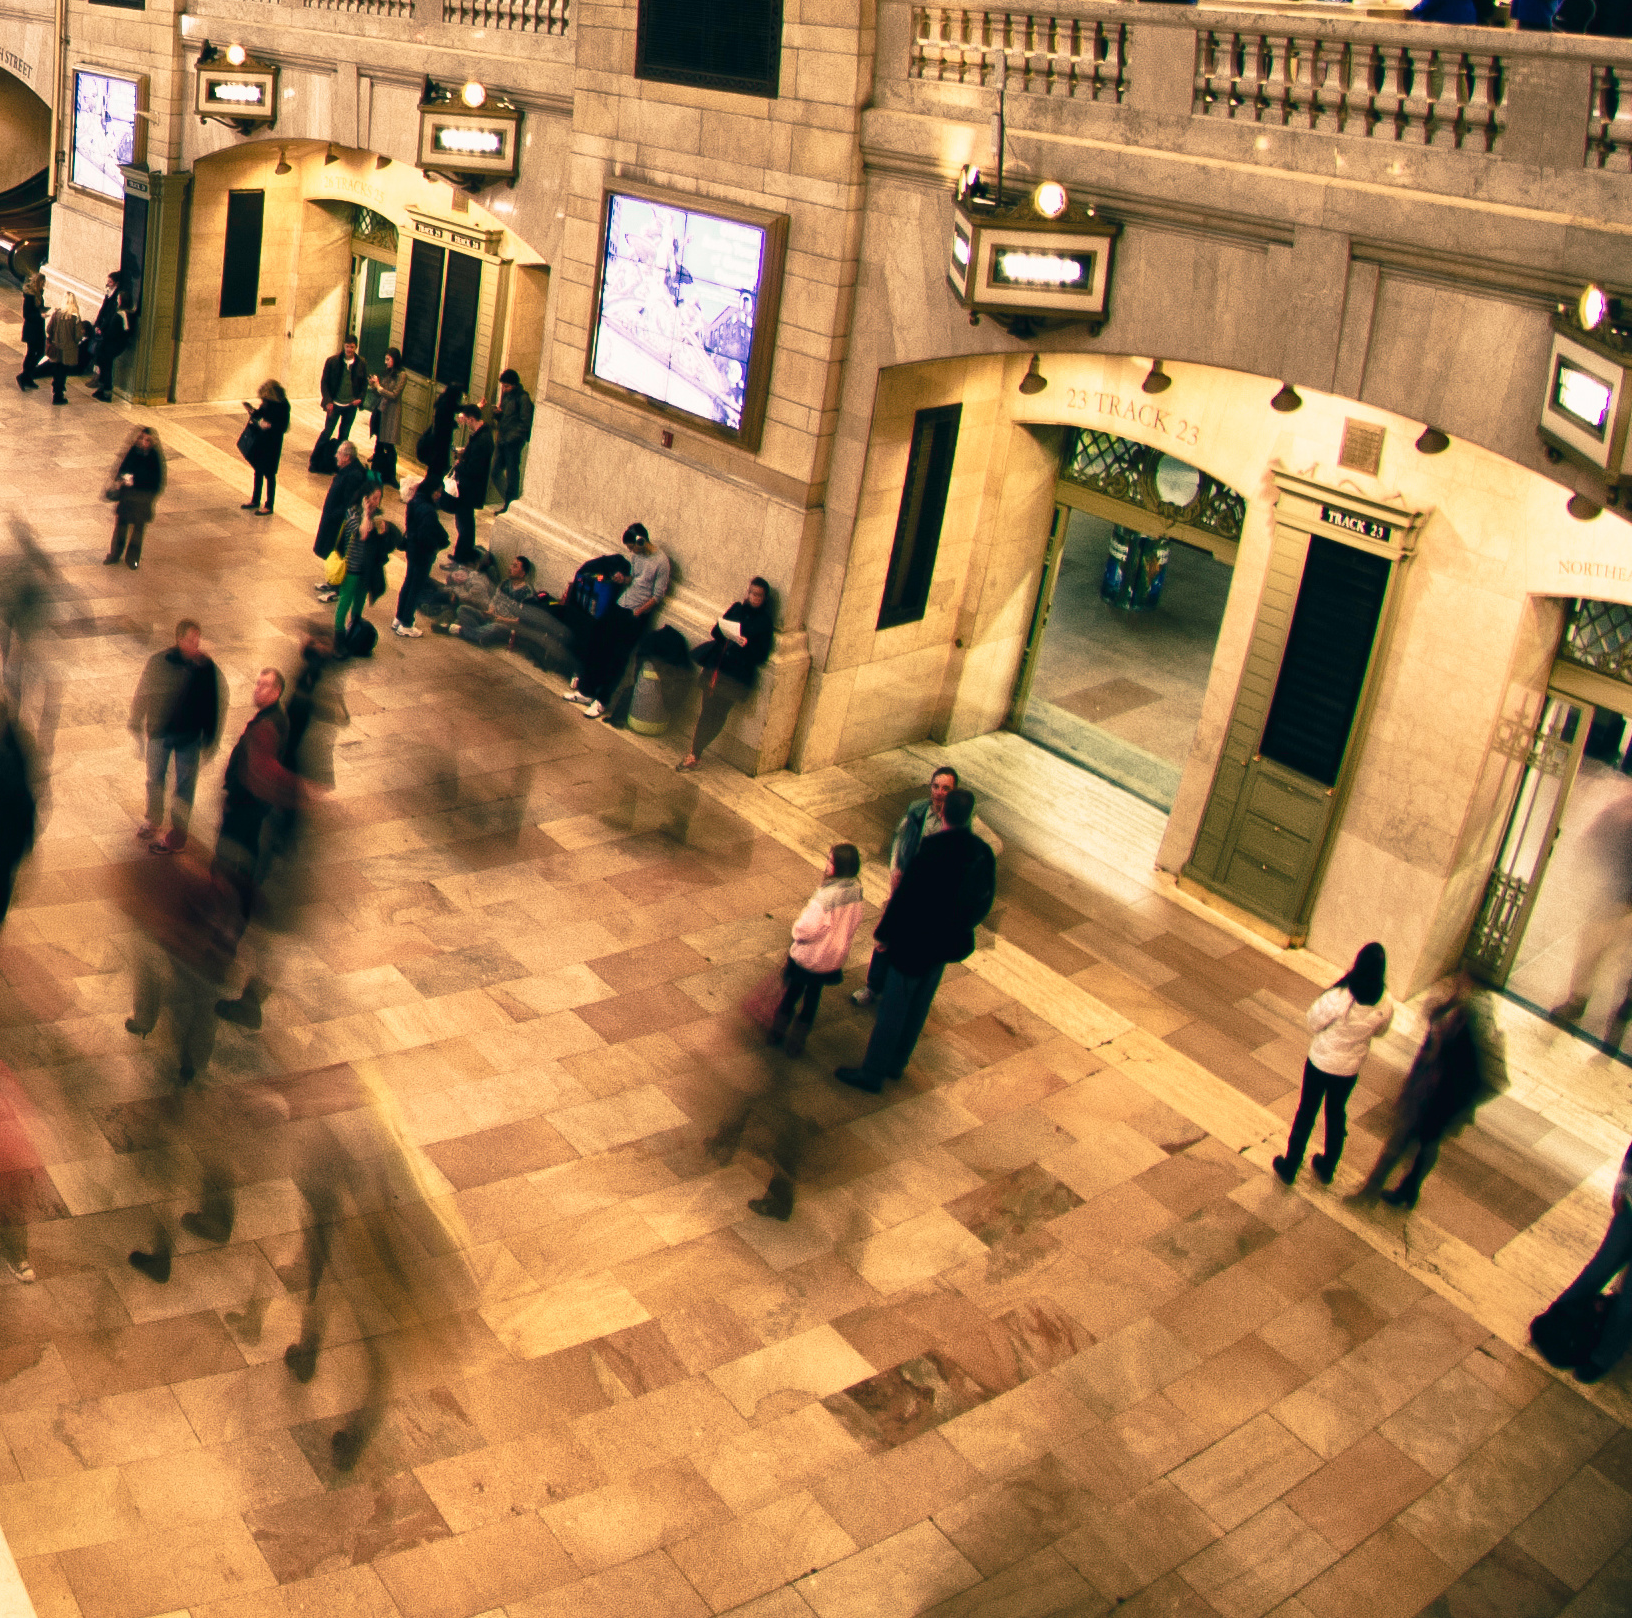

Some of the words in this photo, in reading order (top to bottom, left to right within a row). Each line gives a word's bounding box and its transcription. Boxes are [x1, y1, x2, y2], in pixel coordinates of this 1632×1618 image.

[5, 51, 33, 79] STREET
[335, 176, 373, 197] TRACKS
[1067, 389, 1087, 409] 23
[1095, 391, 1172, 433] TRACK
[1176, 420, 1200, 446] 23
[1328, 510, 1366, 534] TRACK
[1370, 524, 1385, 539] 23
